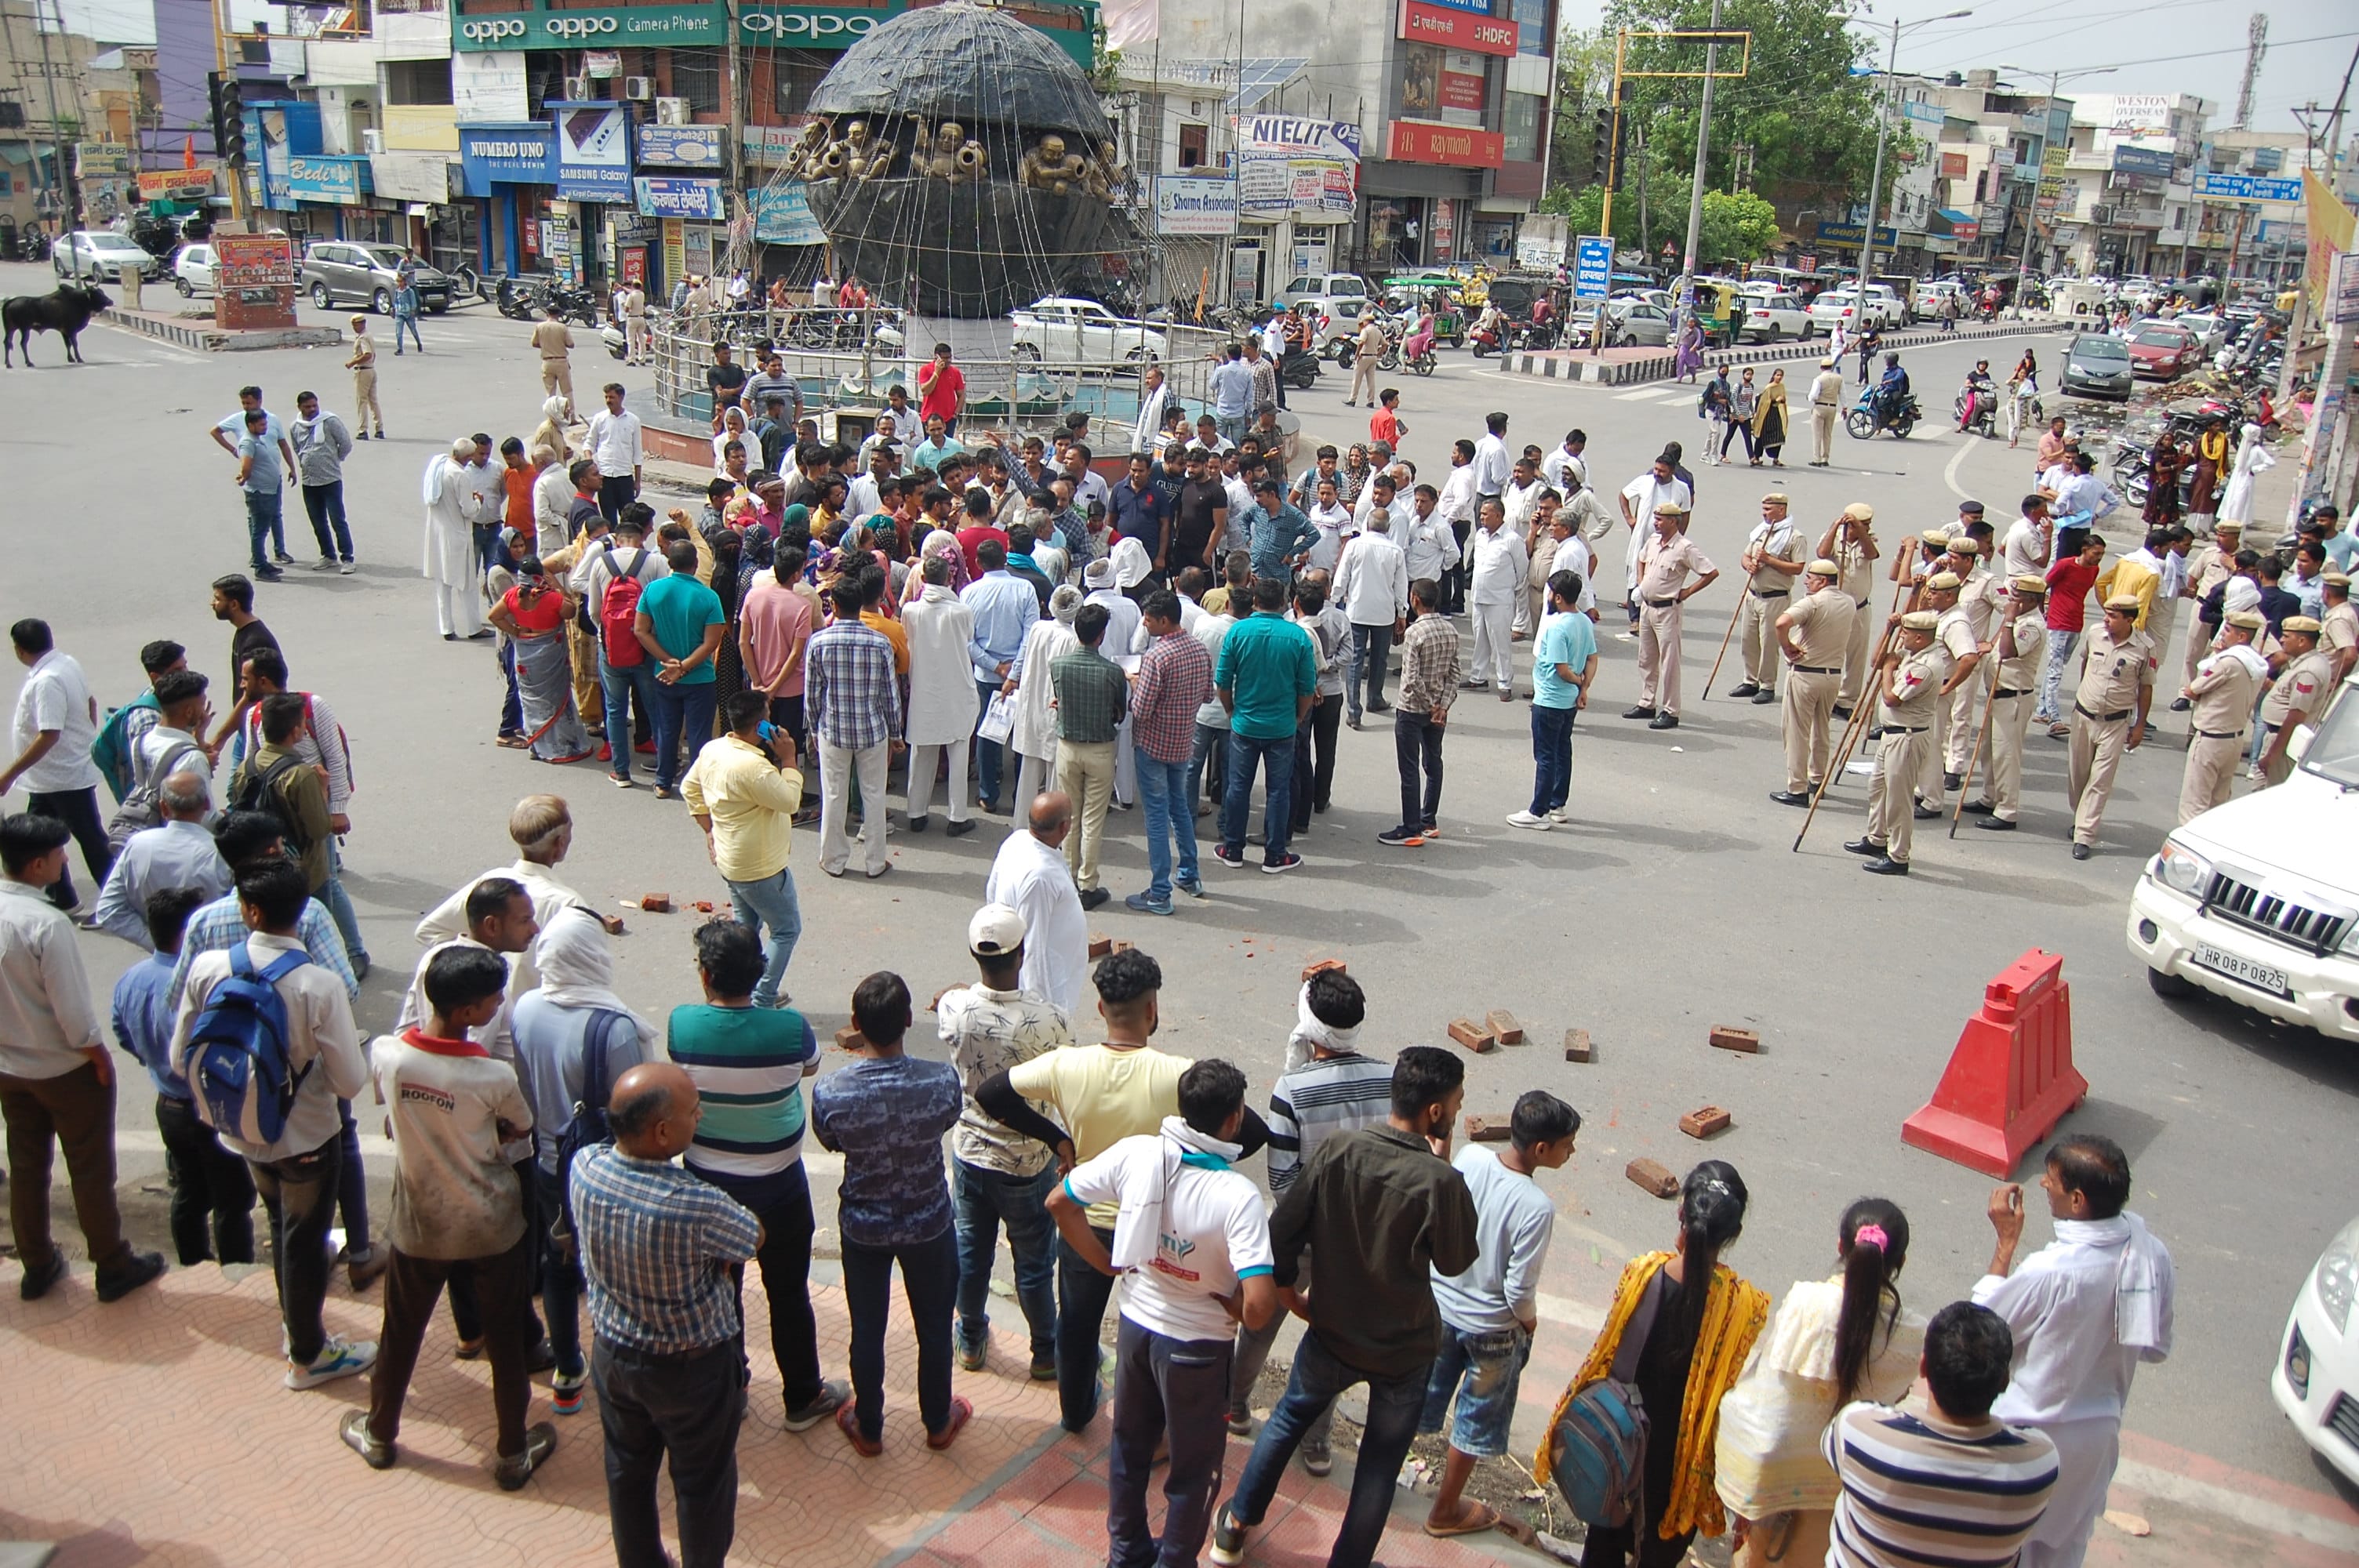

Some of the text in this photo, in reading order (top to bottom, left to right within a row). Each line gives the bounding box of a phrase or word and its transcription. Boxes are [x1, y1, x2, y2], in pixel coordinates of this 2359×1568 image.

[463, 20, 526, 43] oppo
[547, 16, 618, 39] oppo
[627, 15, 709, 32] Camera Phone
[742, 13, 879, 39] oppo
[1482, 26, 1512, 45] HDFC
[2117, 96, 2167, 106] WESTON
[2116, 107, 2165, 116] OVERSEAS
[1252, 119, 1330, 146] NIELIT
[84, 143, 126, 155] शर्मा टायर
[471, 141, 545, 158] NUMERO UNO
[1430, 133, 1471, 160] Raymond
[289, 159, 331, 182] Bedi
[560, 168, 628, 184] SAMSUNG Galaxy
[142, 175, 162, 190] शर्मा
[165, 177, 187, 188] टायर
[1173, 191, 1201, 211] Sharma
[1824, 227, 1888, 241] GOODYAR
[1156, 479, 1183, 494] GUESS
[2205, 949, 2284, 989] HR 08 P 0825
